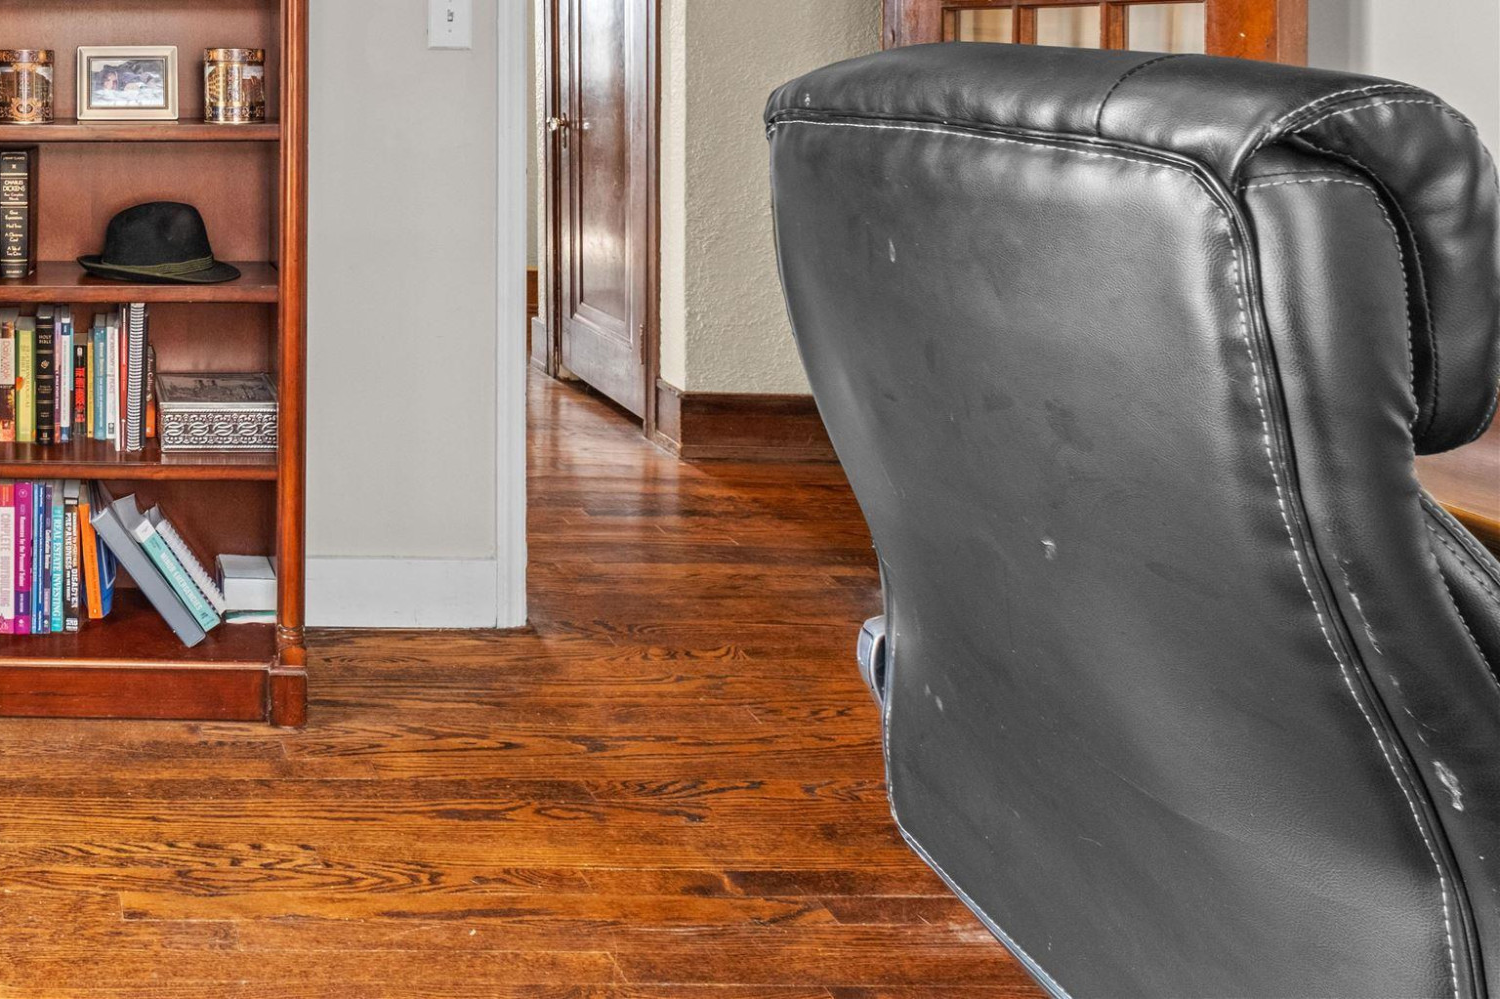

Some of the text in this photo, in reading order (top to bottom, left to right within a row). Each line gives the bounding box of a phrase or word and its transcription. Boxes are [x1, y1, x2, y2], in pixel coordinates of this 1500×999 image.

[52, 519, 63, 617] REAL ESTATE INVESTING
